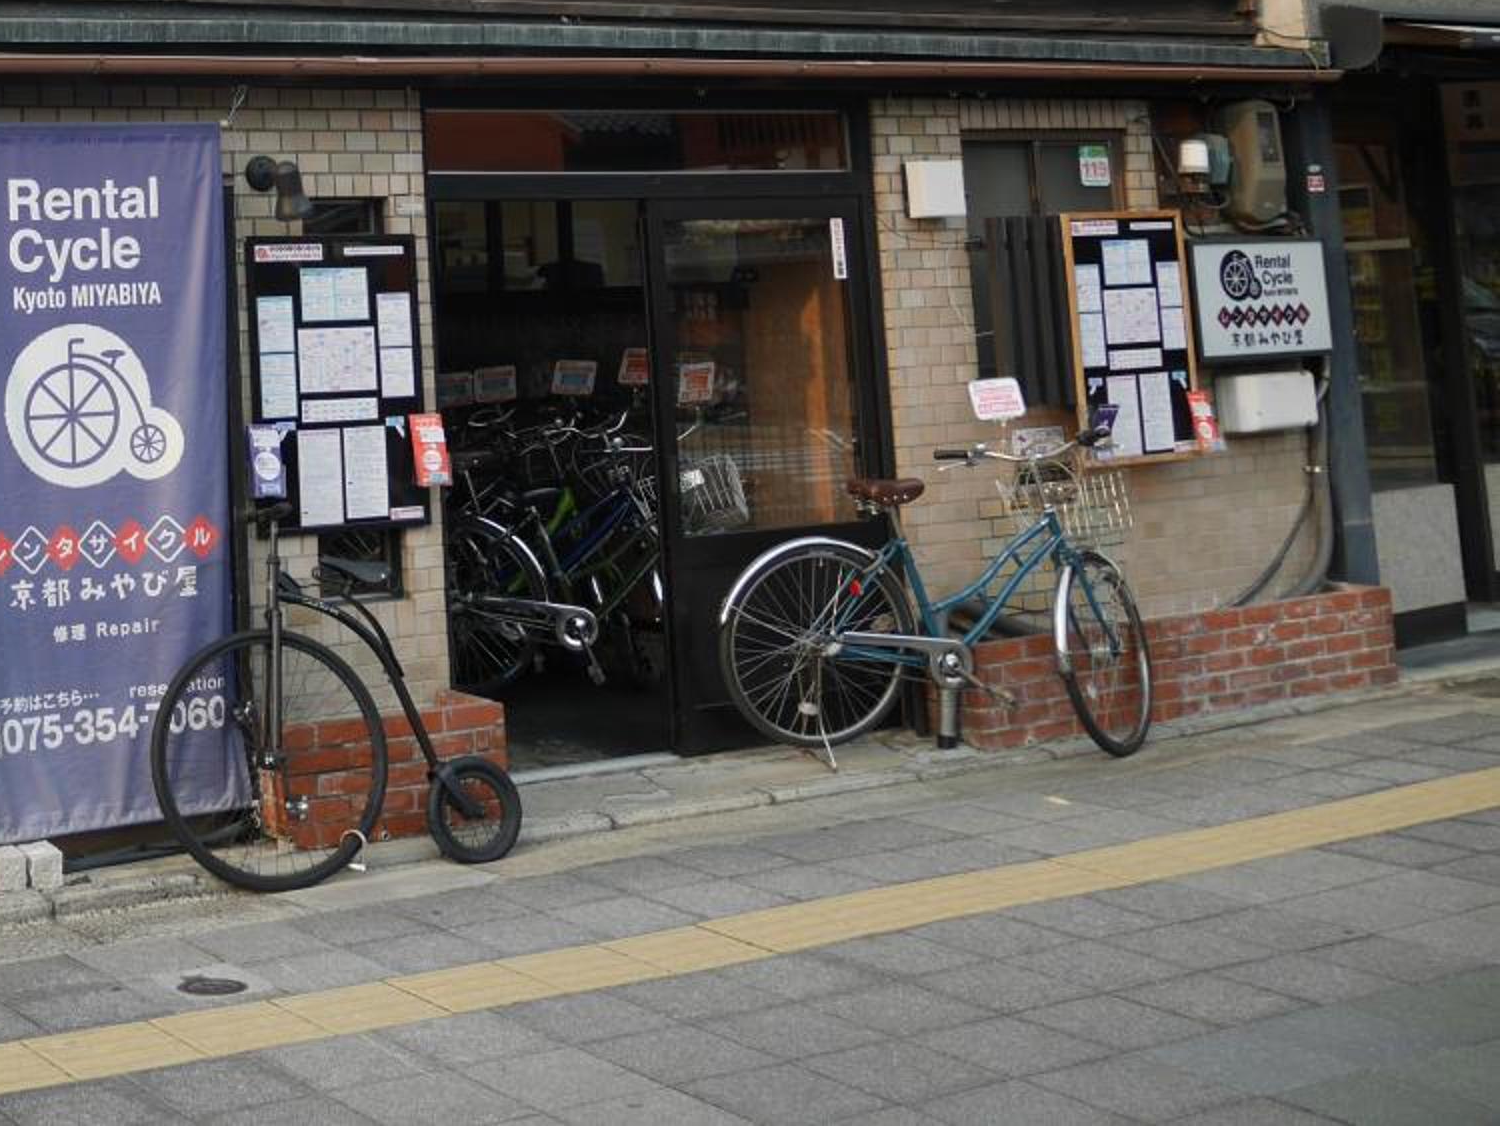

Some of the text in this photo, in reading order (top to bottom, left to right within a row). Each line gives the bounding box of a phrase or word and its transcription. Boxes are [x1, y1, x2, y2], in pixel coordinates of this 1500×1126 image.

[7, 176, 160, 222] Rental
[8, 228, 141, 283] Cycle
[1255, 254, 1291, 269] Rental
[1262, 270, 1293, 287] Cycle
[12, 281, 162, 315] Kyoto MIYABIYA
[9, 565, 198, 611] 京都みやび屋
[53, 617, 161, 643] 修理 Repair
[129, 674, 225, 700] reseation
